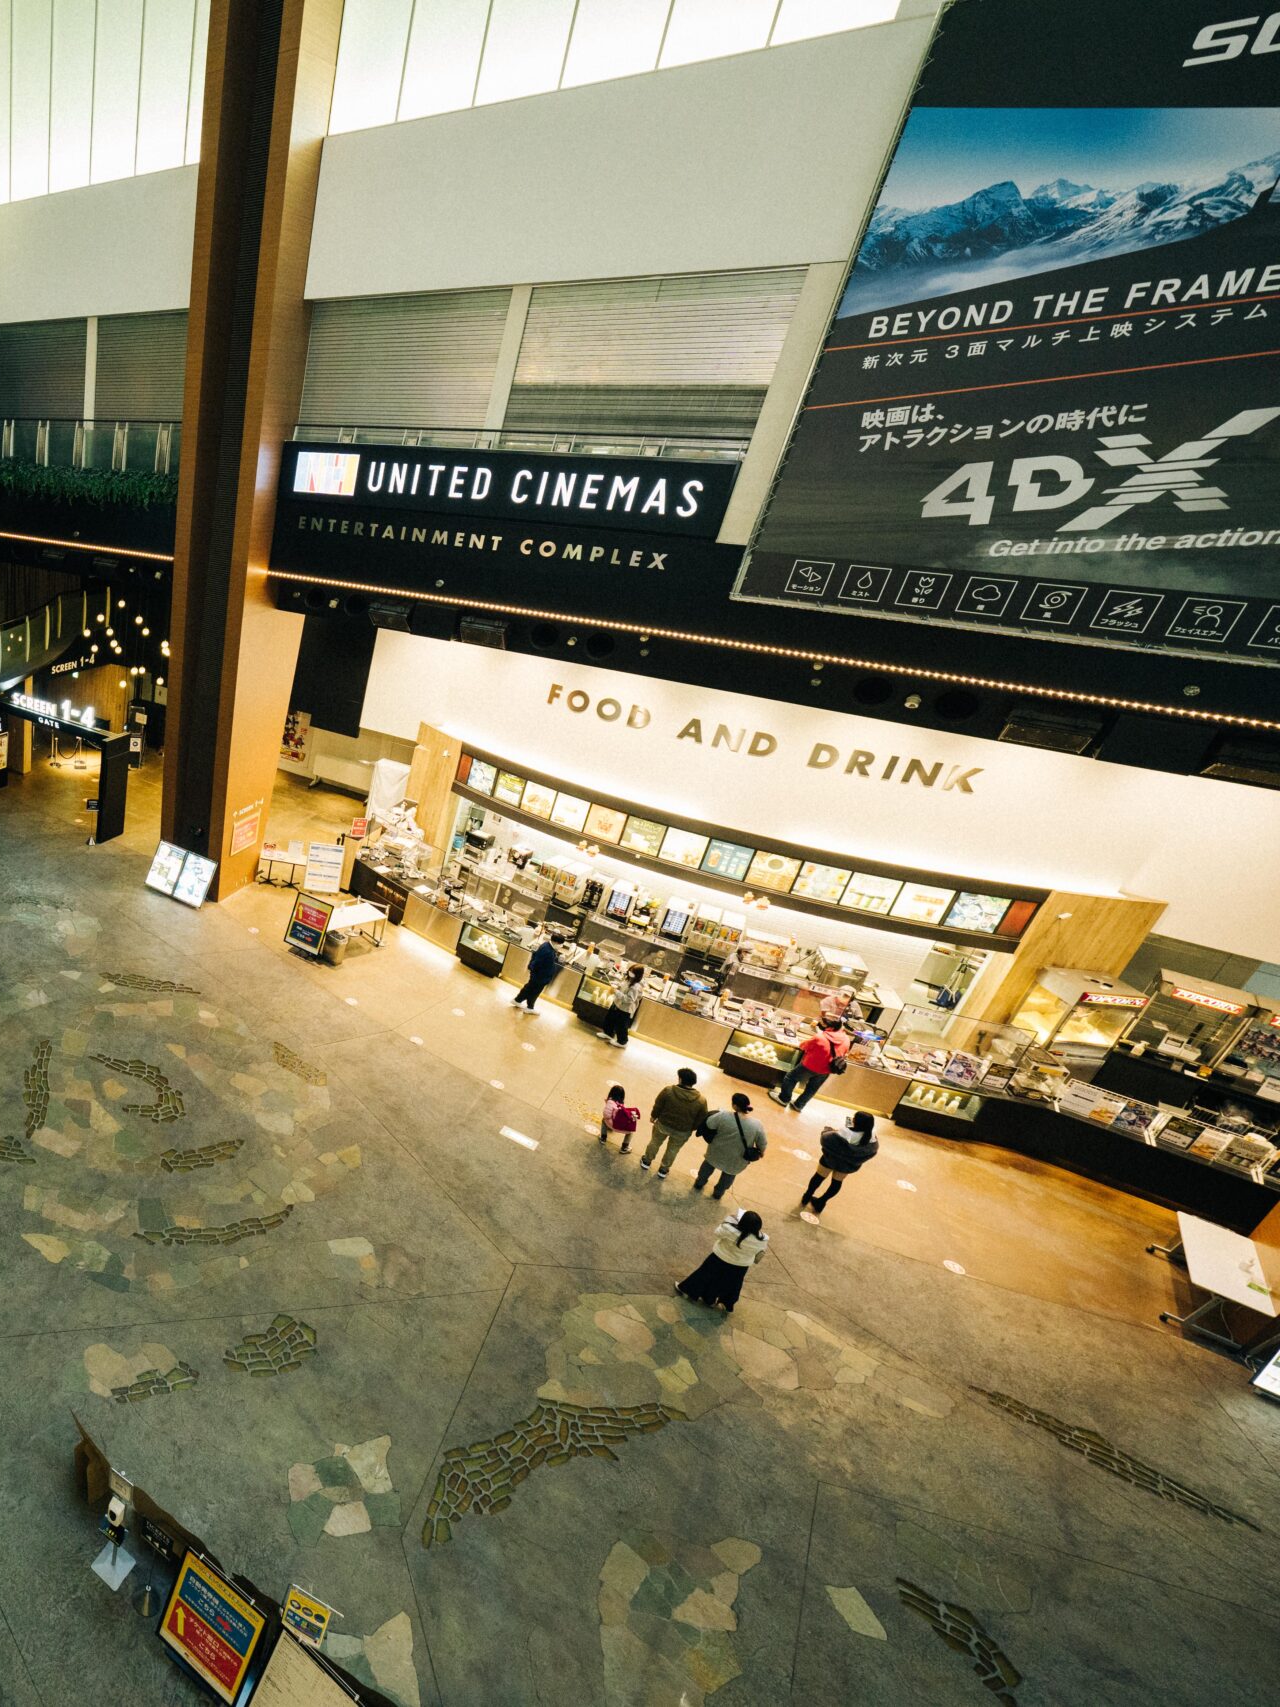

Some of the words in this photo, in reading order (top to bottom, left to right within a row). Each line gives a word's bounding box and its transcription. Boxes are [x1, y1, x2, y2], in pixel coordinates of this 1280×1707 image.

[867, 300, 1014, 339] BEYOND
[1032, 287, 1109, 320] THE
[1124, 267, 1280, 310] FRAME
[862, 347, 929, 370] 新次元
[945, 306, 1269, 360] 3面マルチ上映システム
[858, 403, 1148, 453] アトラクションの時代に
[861, 402, 946, 429] 映画は、
[920, 406, 1280, 533] 4DX
[366, 461, 493, 501] UNITED
[510, 469, 705, 518] CINEMAS
[298, 515, 503, 552] ENTERTAINMENT
[519, 538, 669, 571] COMPLEX
[988, 537, 1043, 558] Get
[1047, 535, 1107, 556] into
[1115, 532, 1168, 552] the
[1174, 527, 1280, 550] action
[1100, 617, 1139, 628] フラッシュ
[1173, 626, 1223, 637] フェイスエアー
[51, 660, 78, 675] SCREEN
[80, 653, 95, 667] 1-4
[11, 691, 58, 717] SCREEN
[60, 699, 95, 728] 1-4
[38, 717, 60, 729] GATE
[547, 683, 652, 730] FOOD
[676, 717, 780, 758] AND
[807, 743, 986, 795] DRINK
[1084, 993, 1144, 1006] POPCORN
[1173, 988, 1238, 1013] POPCORN
